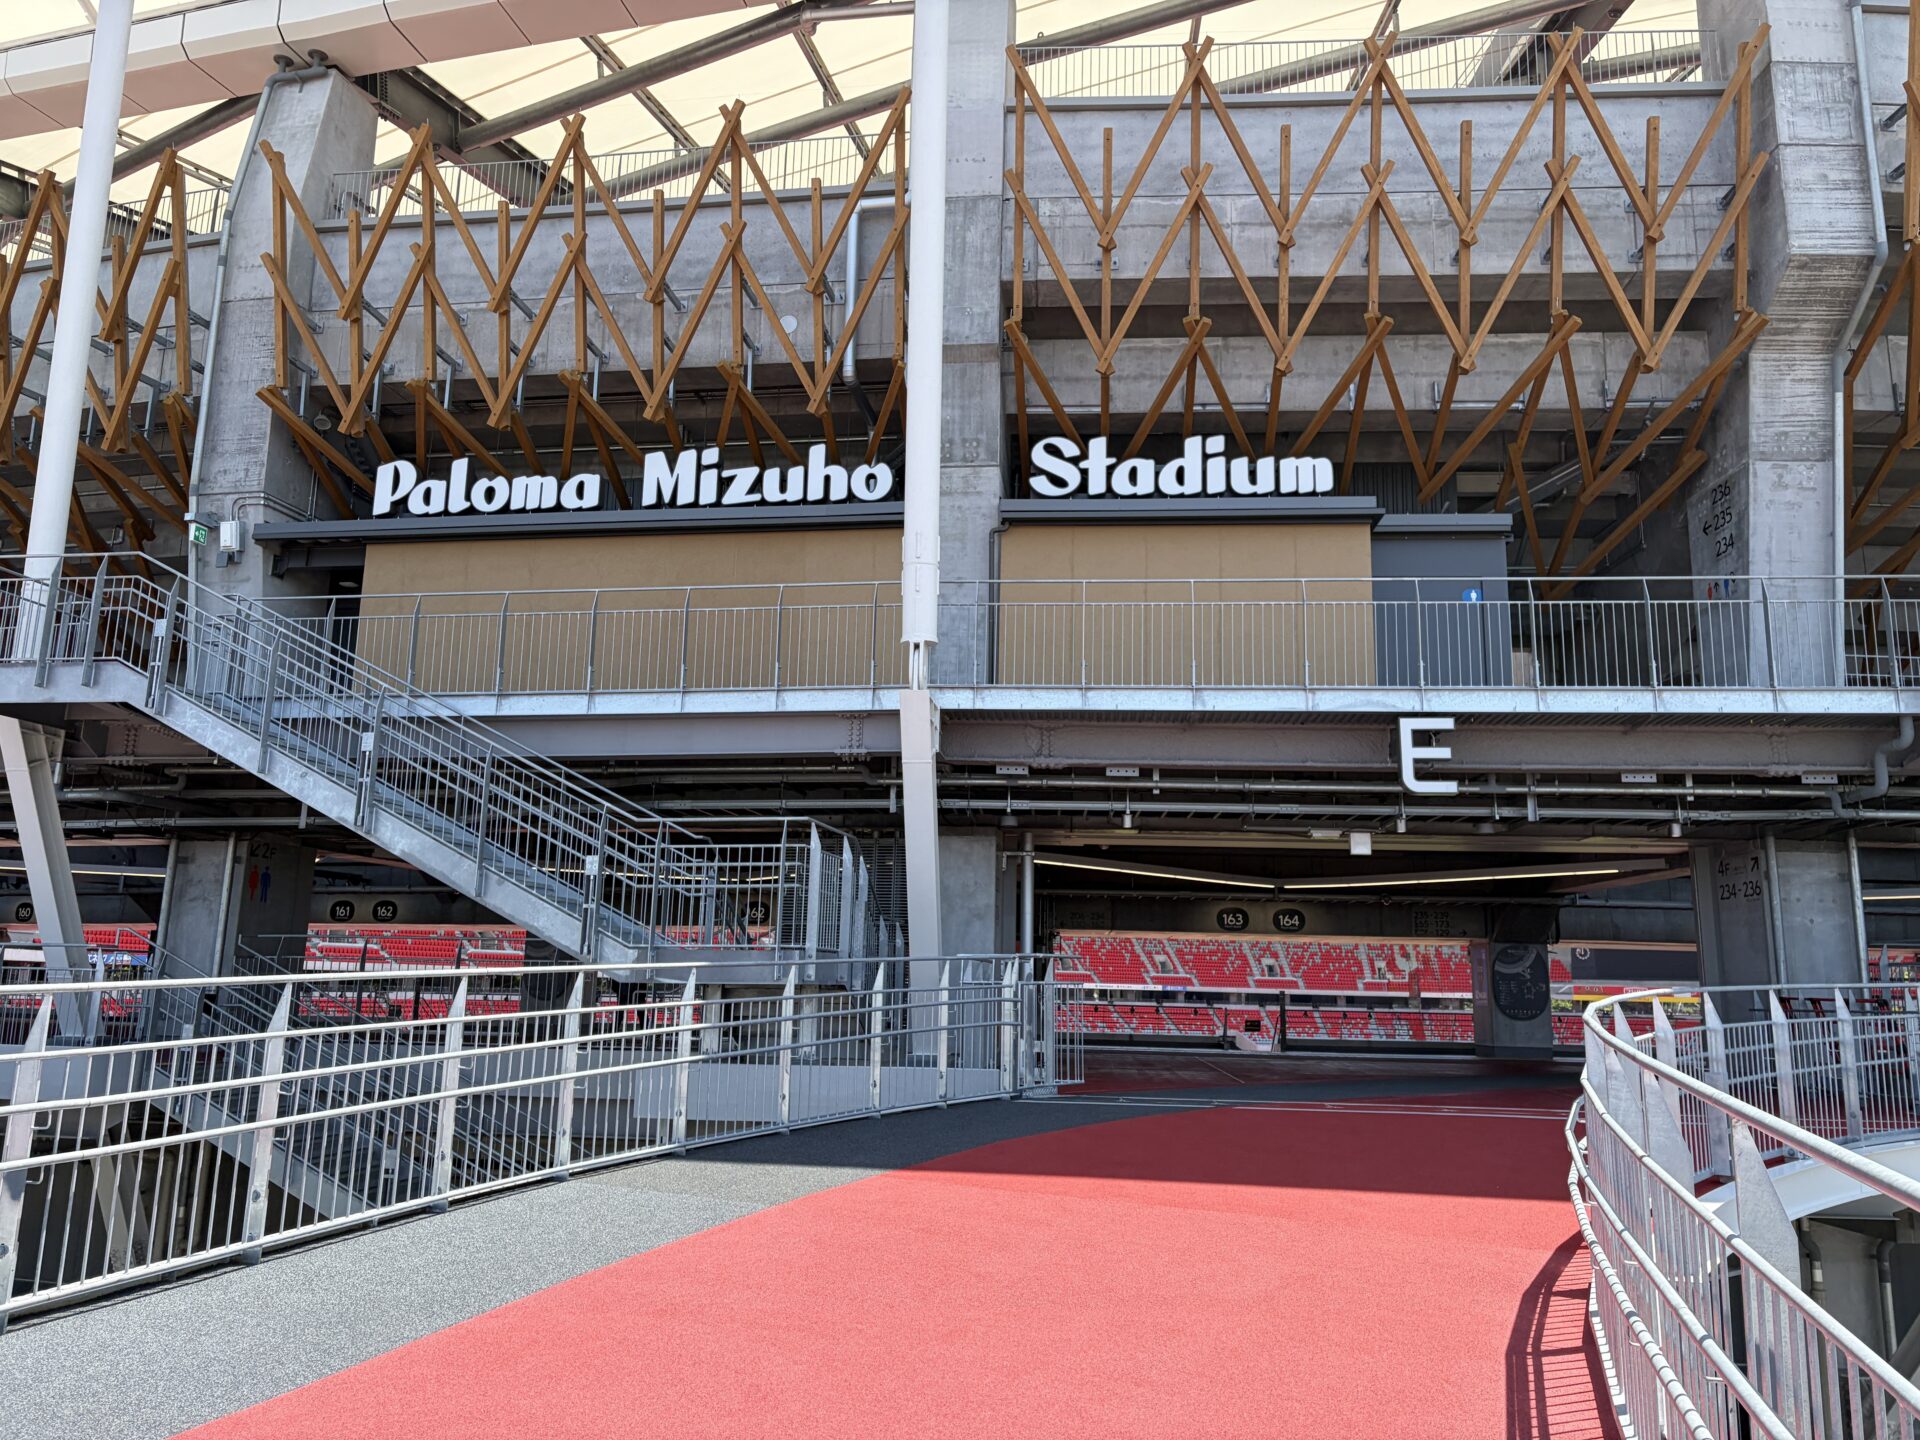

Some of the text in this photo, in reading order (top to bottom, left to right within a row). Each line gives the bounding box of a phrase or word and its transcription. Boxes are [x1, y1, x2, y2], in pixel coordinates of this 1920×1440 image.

[372, 434, 1334, 516] Paloma Mizuho Stadium
[1711, 480, 1731, 505] 236
[1713, 506, 1733, 532] 235
[1715, 533, 1734, 558] 234
[1398, 716, 1459, 795] E
[262, 842, 277, 860] 2F
[1718, 860, 1731, 877] 4F
[1719, 880, 1761, 900] 234-236
[18, 907, 31, 917] 160
[335, 905, 350, 917] 161
[377, 905, 393, 917] 162
[1222, 913, 1243, 925] 163
[1278, 914, 1300, 927] 164
